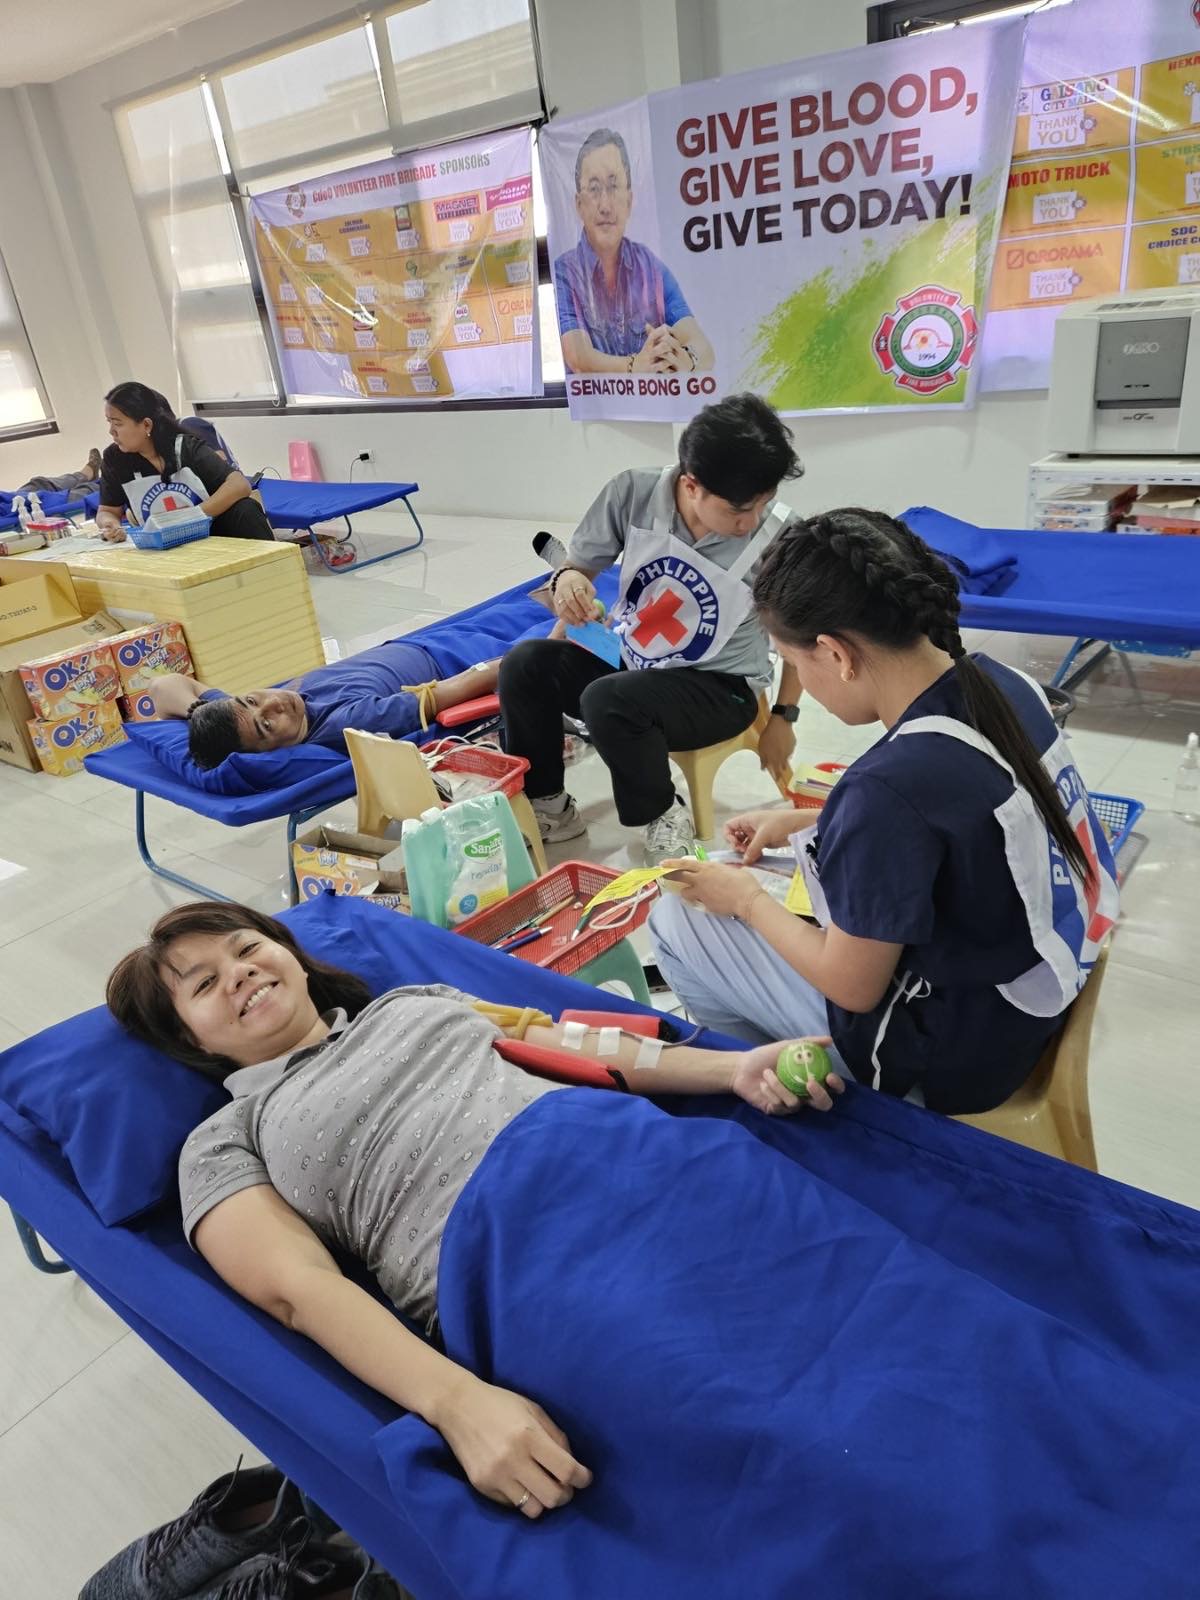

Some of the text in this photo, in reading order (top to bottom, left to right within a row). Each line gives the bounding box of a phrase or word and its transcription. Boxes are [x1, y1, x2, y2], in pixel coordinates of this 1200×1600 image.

[676, 66, 978, 158] GIVE BLOOD,
[1038, 115, 1077, 130] THANK
[1037, 127, 1077, 145] YOU
[333, 176, 378, 198] VOLUNTEER
[379, 172, 397, 189] FIRE
[399, 164, 437, 184] BRIGADE
[440, 153, 490, 175] SPONSORS
[680, 127, 933, 206] GIVE LOVE,
[1008, 161, 1111, 189] MOTO TRUCK
[683, 174, 972, 252] GIVE TODAY!
[1040, 197, 1069, 207] THANK
[1040, 207, 1069, 220] YOU
[1148, 237, 1187, 249] CHOICE
[1035, 281, 1066, 294] YOU
[571, 376, 716, 396] SENATOR BONG GO
[142, 482, 192, 512] PHILIPPINE
[119, 633, 160, 667] OK!
[44, 655, 89, 691] OK!
[52, 710, 96, 748] OK!
